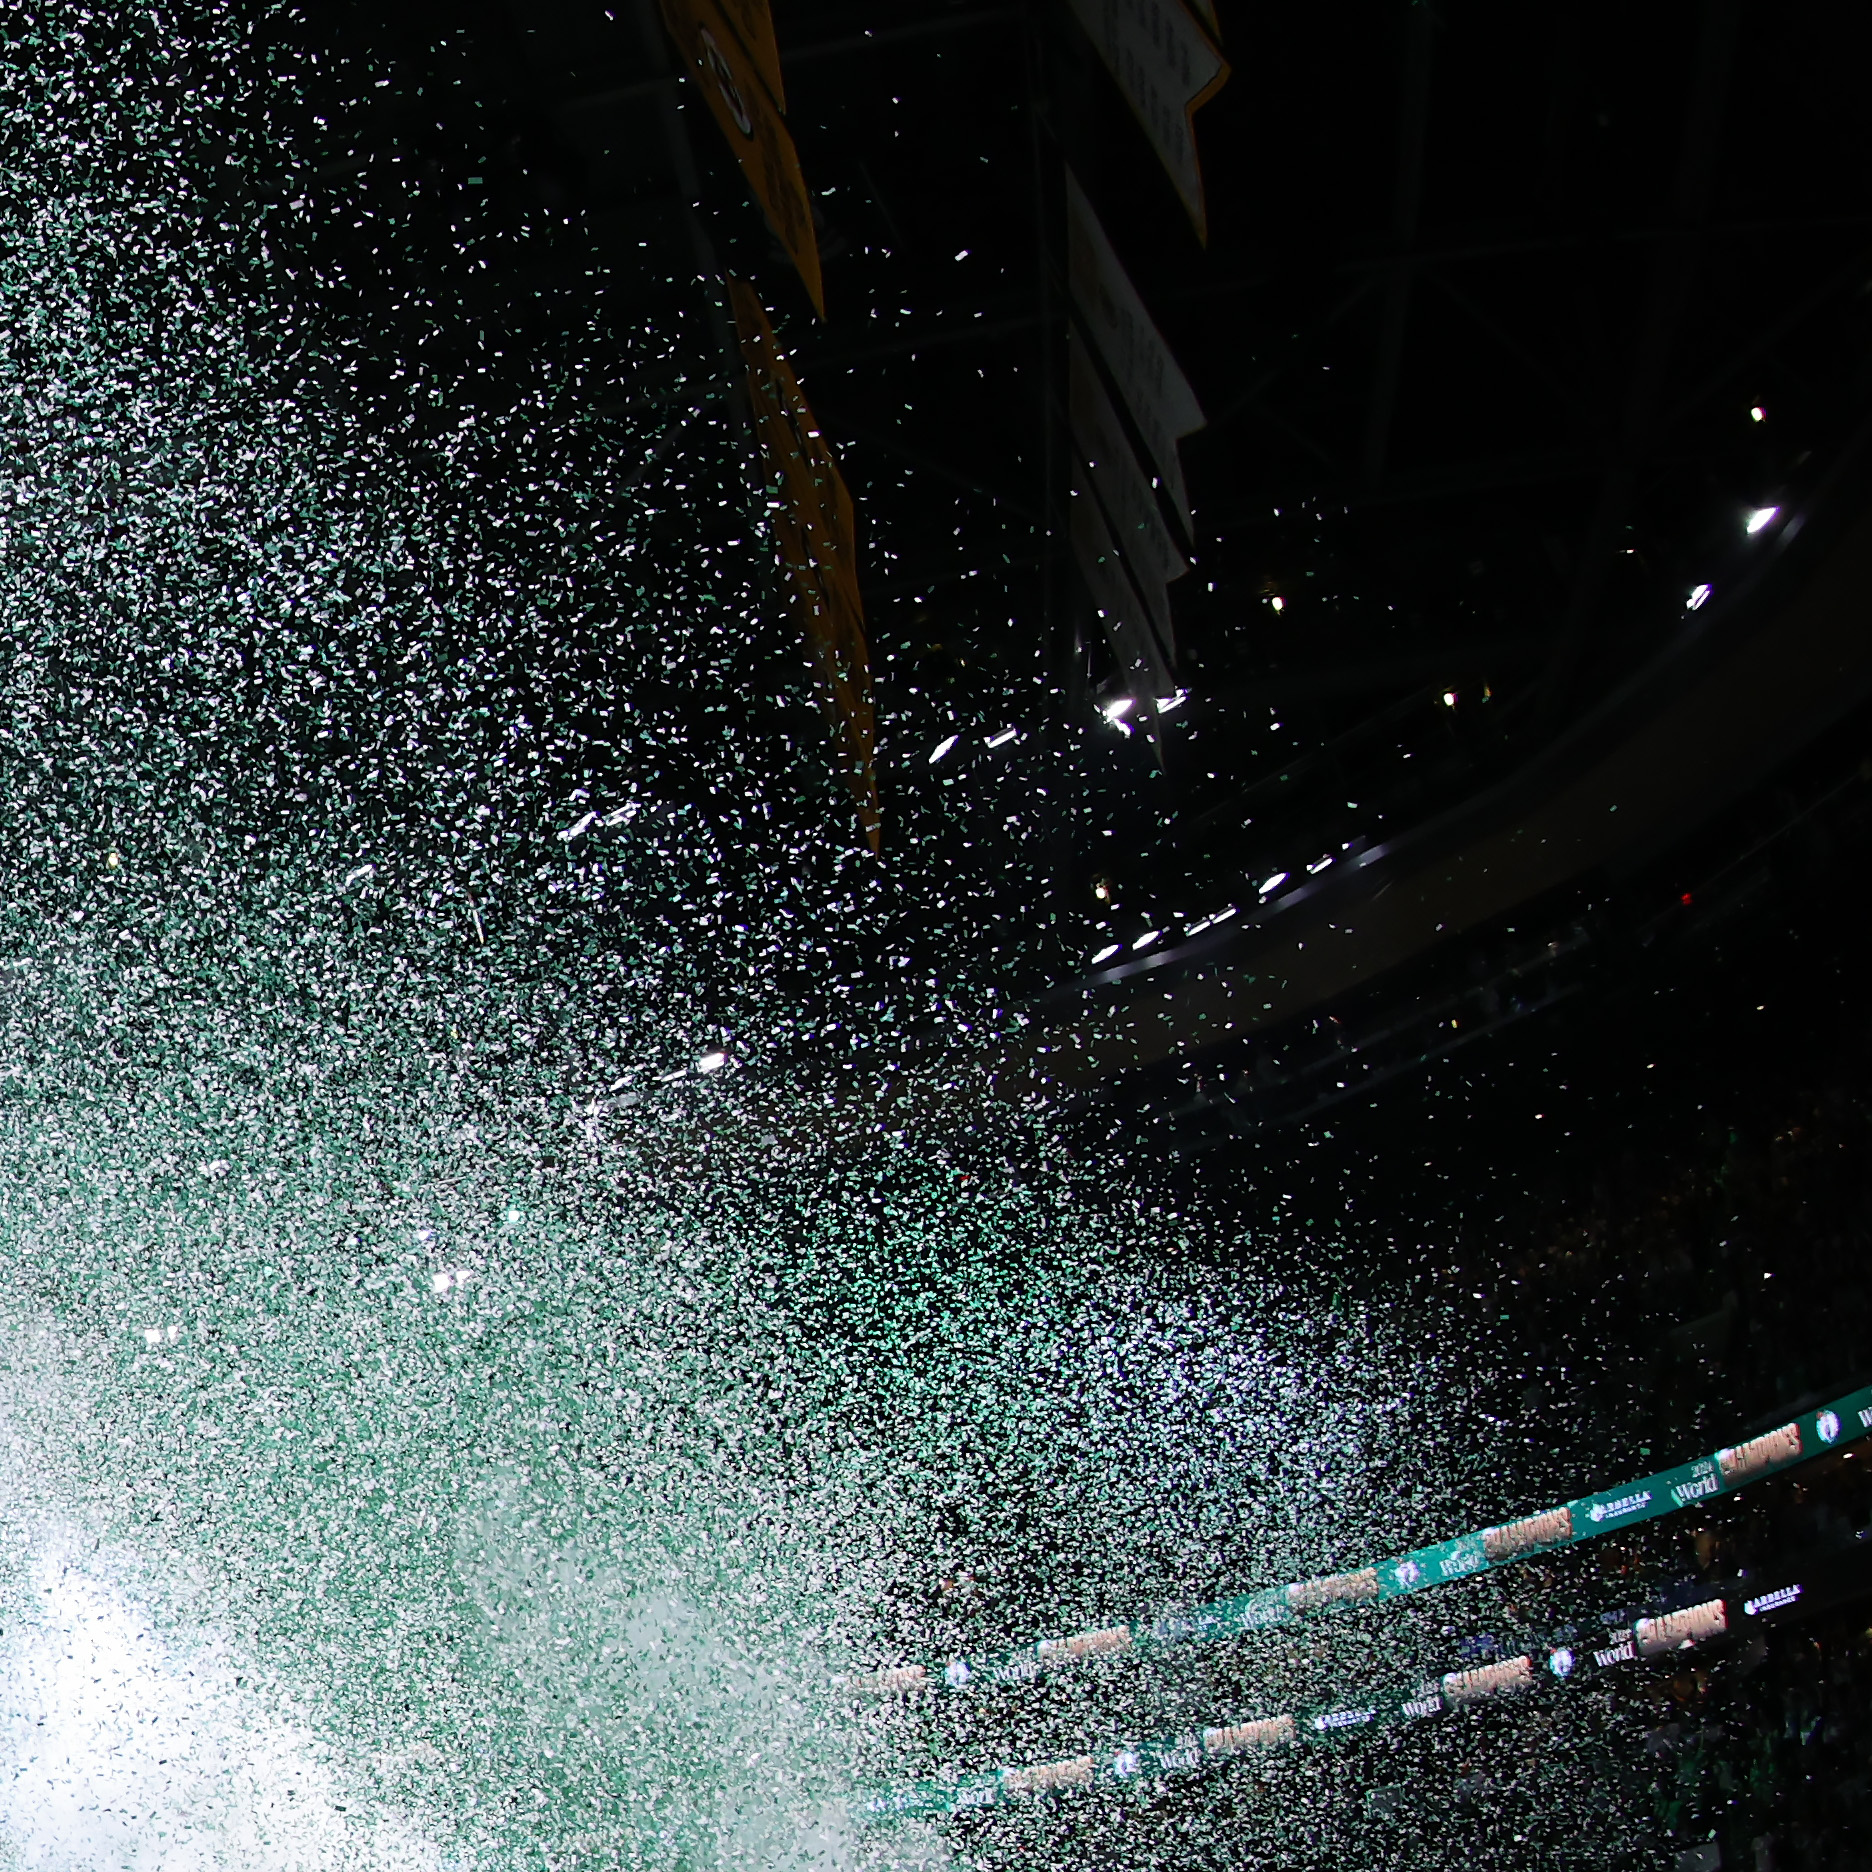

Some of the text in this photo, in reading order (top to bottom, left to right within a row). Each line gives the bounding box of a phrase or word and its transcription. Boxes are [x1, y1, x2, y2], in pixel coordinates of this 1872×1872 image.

[1676, 1473, 1719, 1501] World
[1754, 1583, 1803, 1609] ARBELLA
[1593, 1640, 1637, 1667] World
